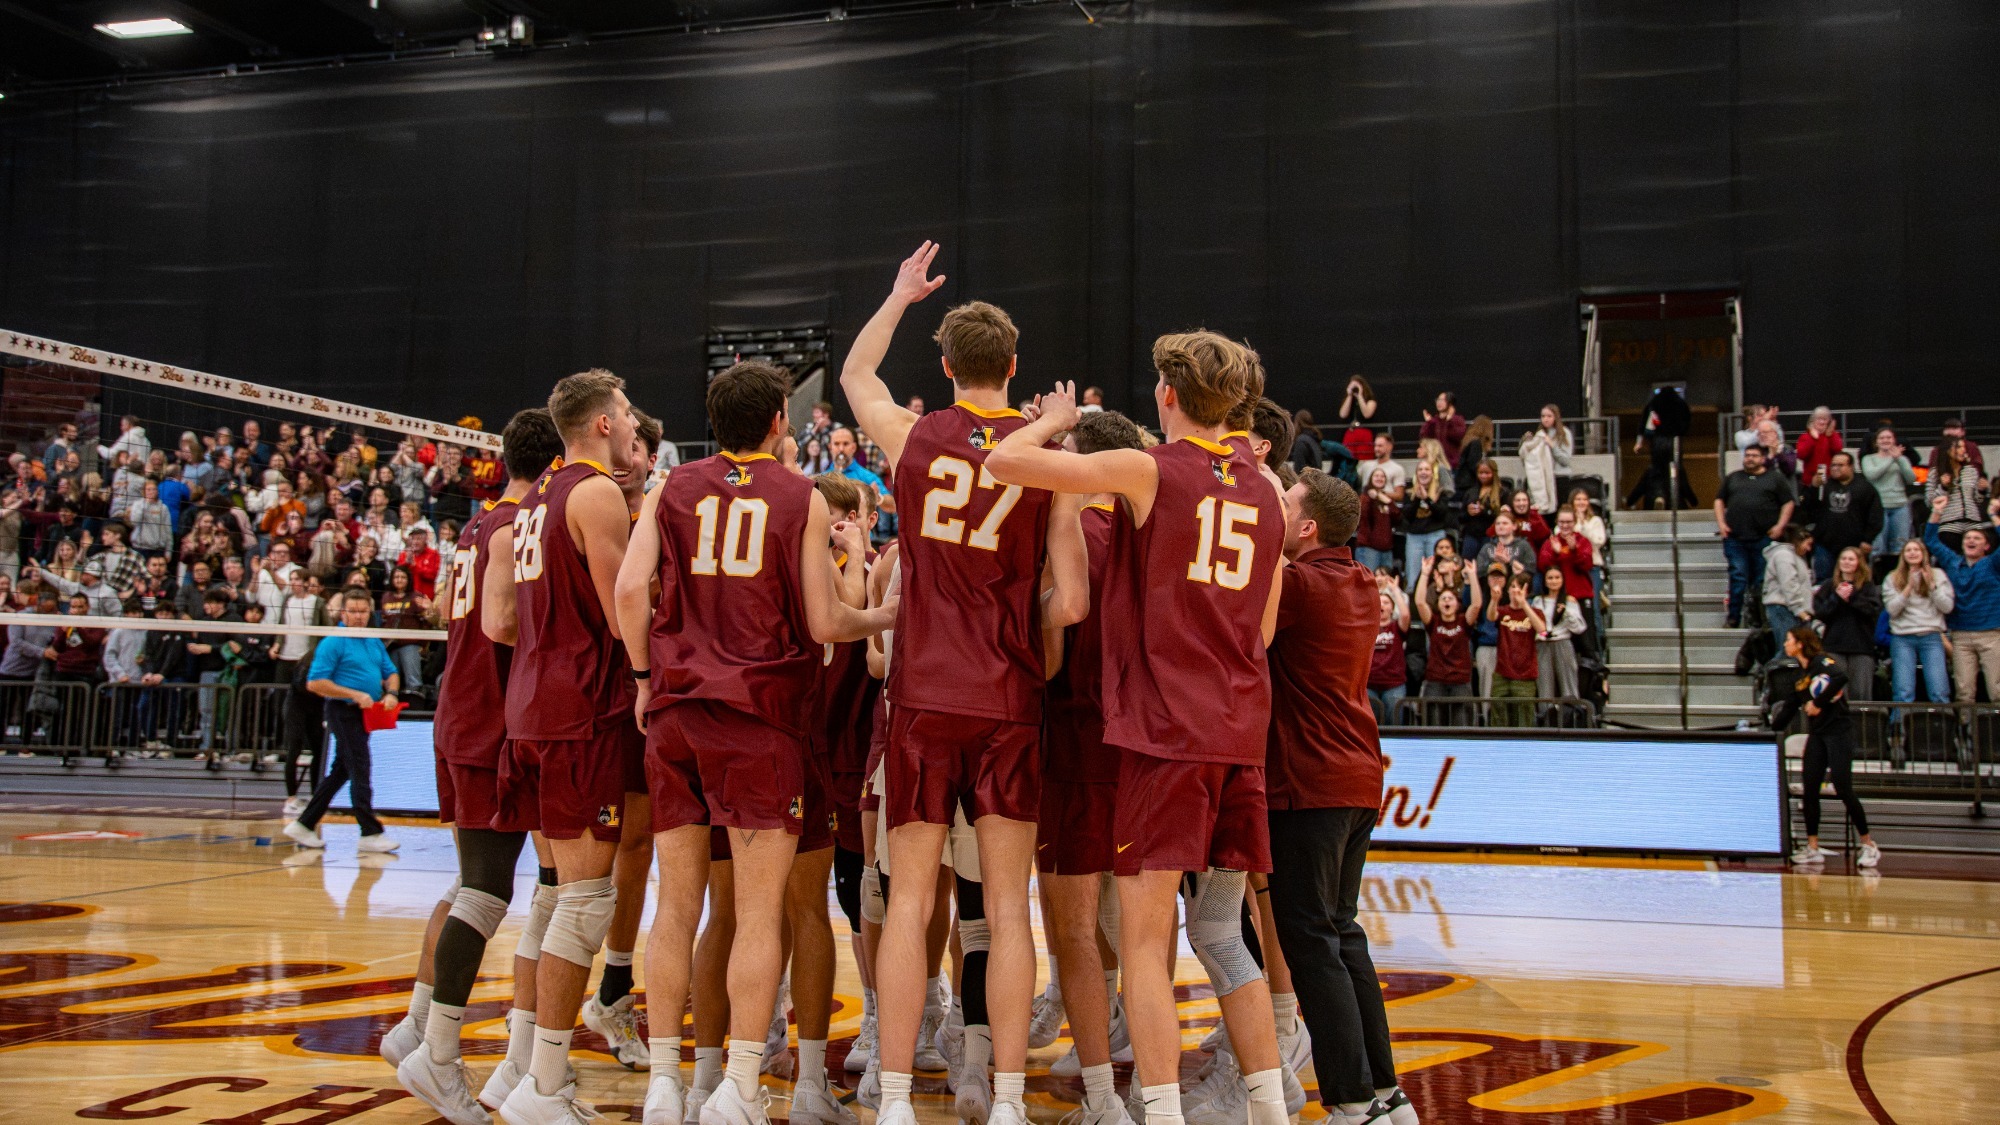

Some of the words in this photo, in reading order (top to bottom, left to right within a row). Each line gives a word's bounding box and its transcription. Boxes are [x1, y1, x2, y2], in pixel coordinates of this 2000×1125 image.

[513, 503, 548, 584] 28
[691, 495, 770, 577] 10
[920, 455, 1024, 552] 27
[1186, 495, 1259, 591] 15
